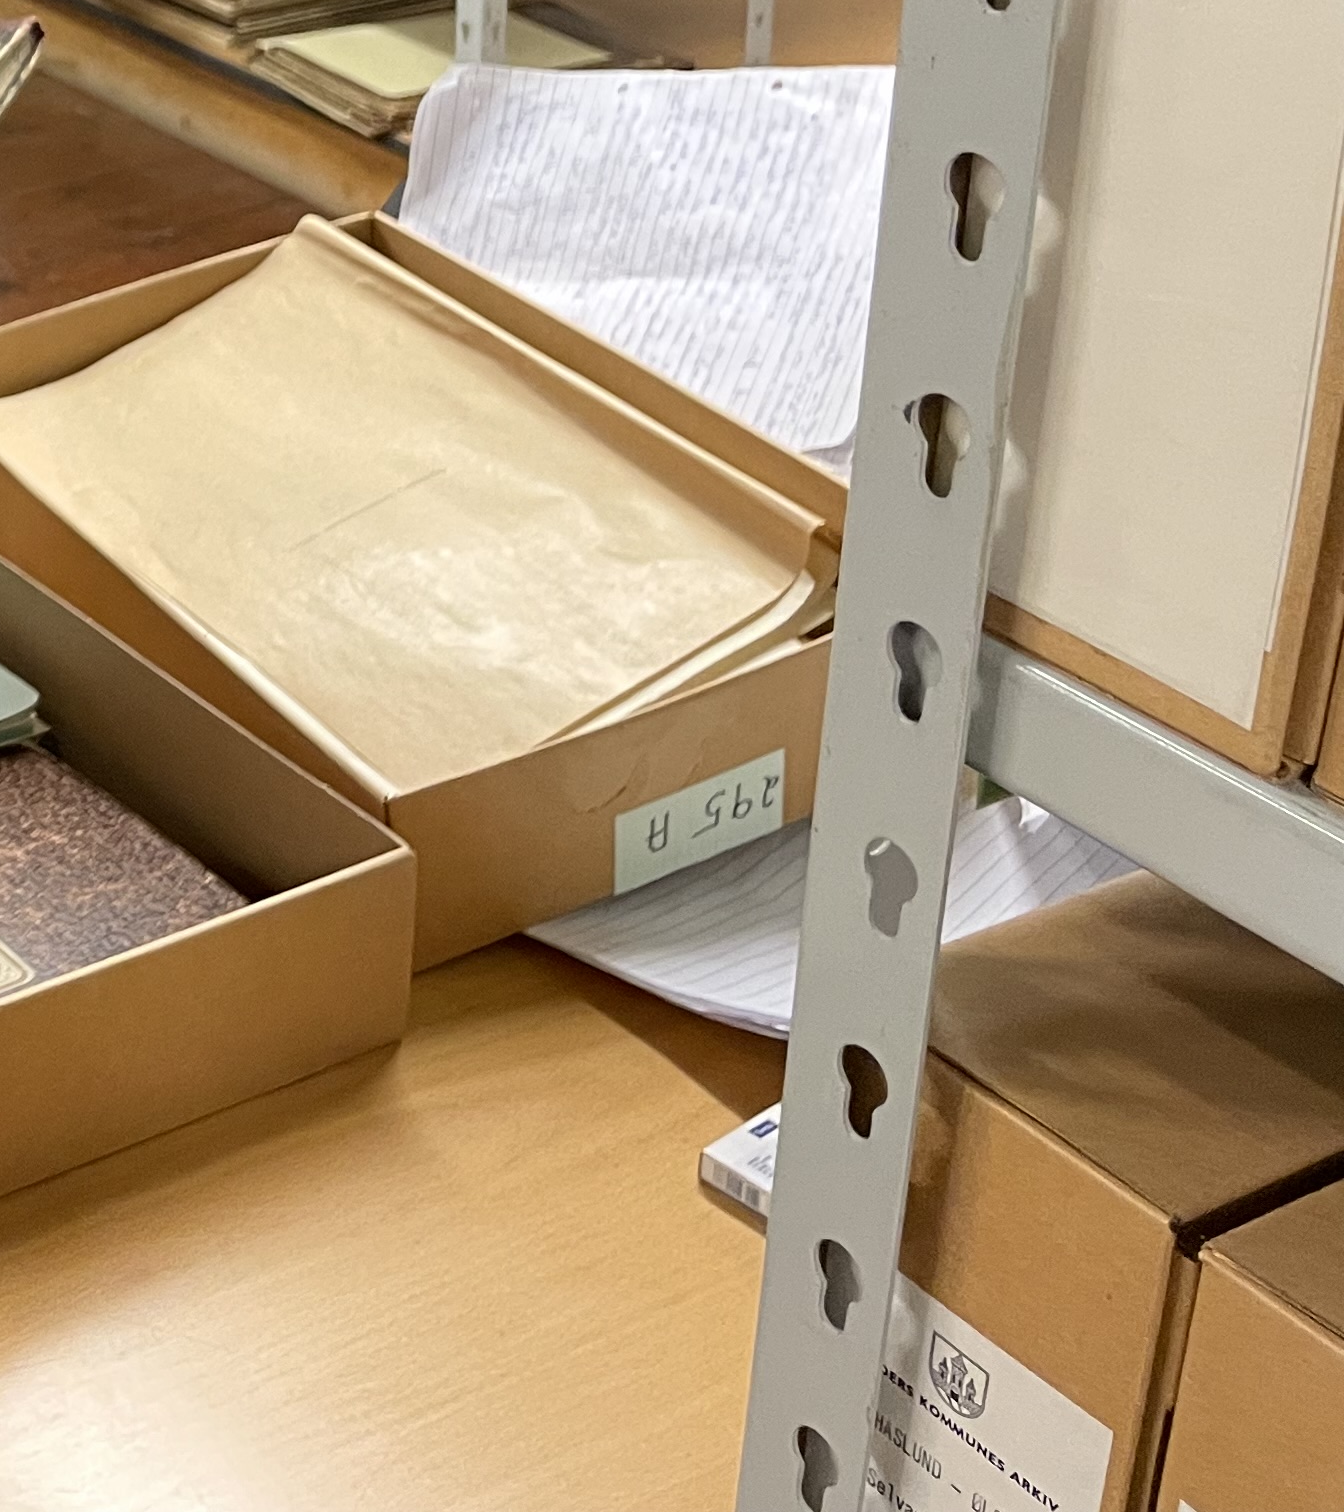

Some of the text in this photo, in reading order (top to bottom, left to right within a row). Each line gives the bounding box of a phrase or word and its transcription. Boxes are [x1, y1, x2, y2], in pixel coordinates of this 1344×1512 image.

[647, 810, 670, 853] A
[874, 1411, 942, 1480] HASLUND
[919, 1394, 1006, 1472] KOMMUNES
[1009, 1471, 1060, 1512] ARKIV
